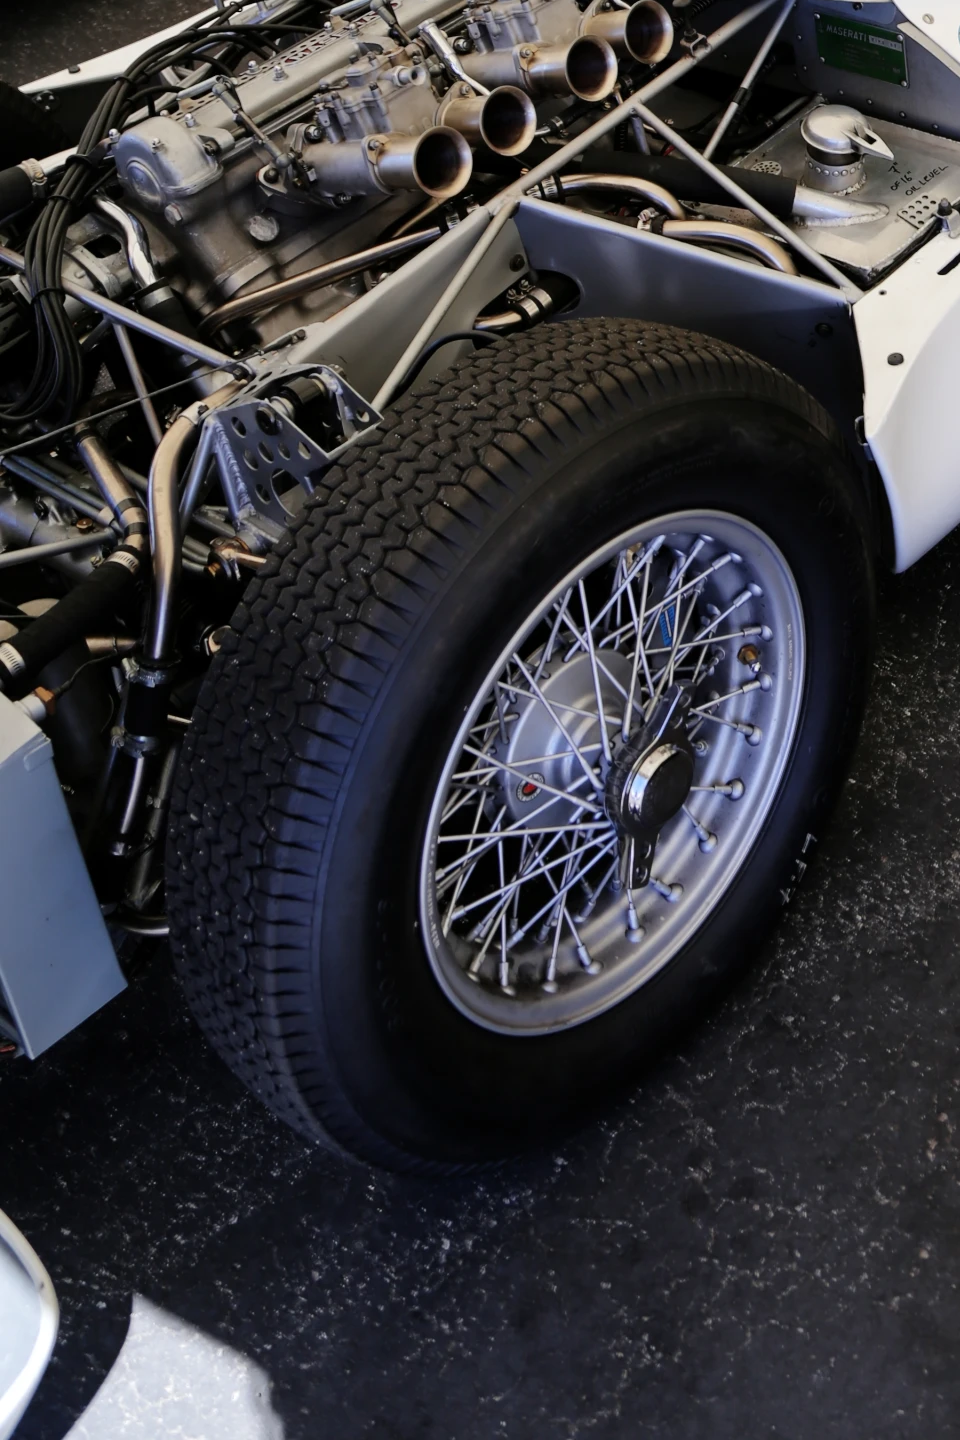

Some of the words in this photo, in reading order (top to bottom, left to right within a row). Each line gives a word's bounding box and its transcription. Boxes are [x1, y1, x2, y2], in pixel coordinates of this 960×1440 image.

[826, 24, 867, 42] MASERATI
[905, 185, 921, 196] OIL
[918, 165, 949, 186] LEVEL
